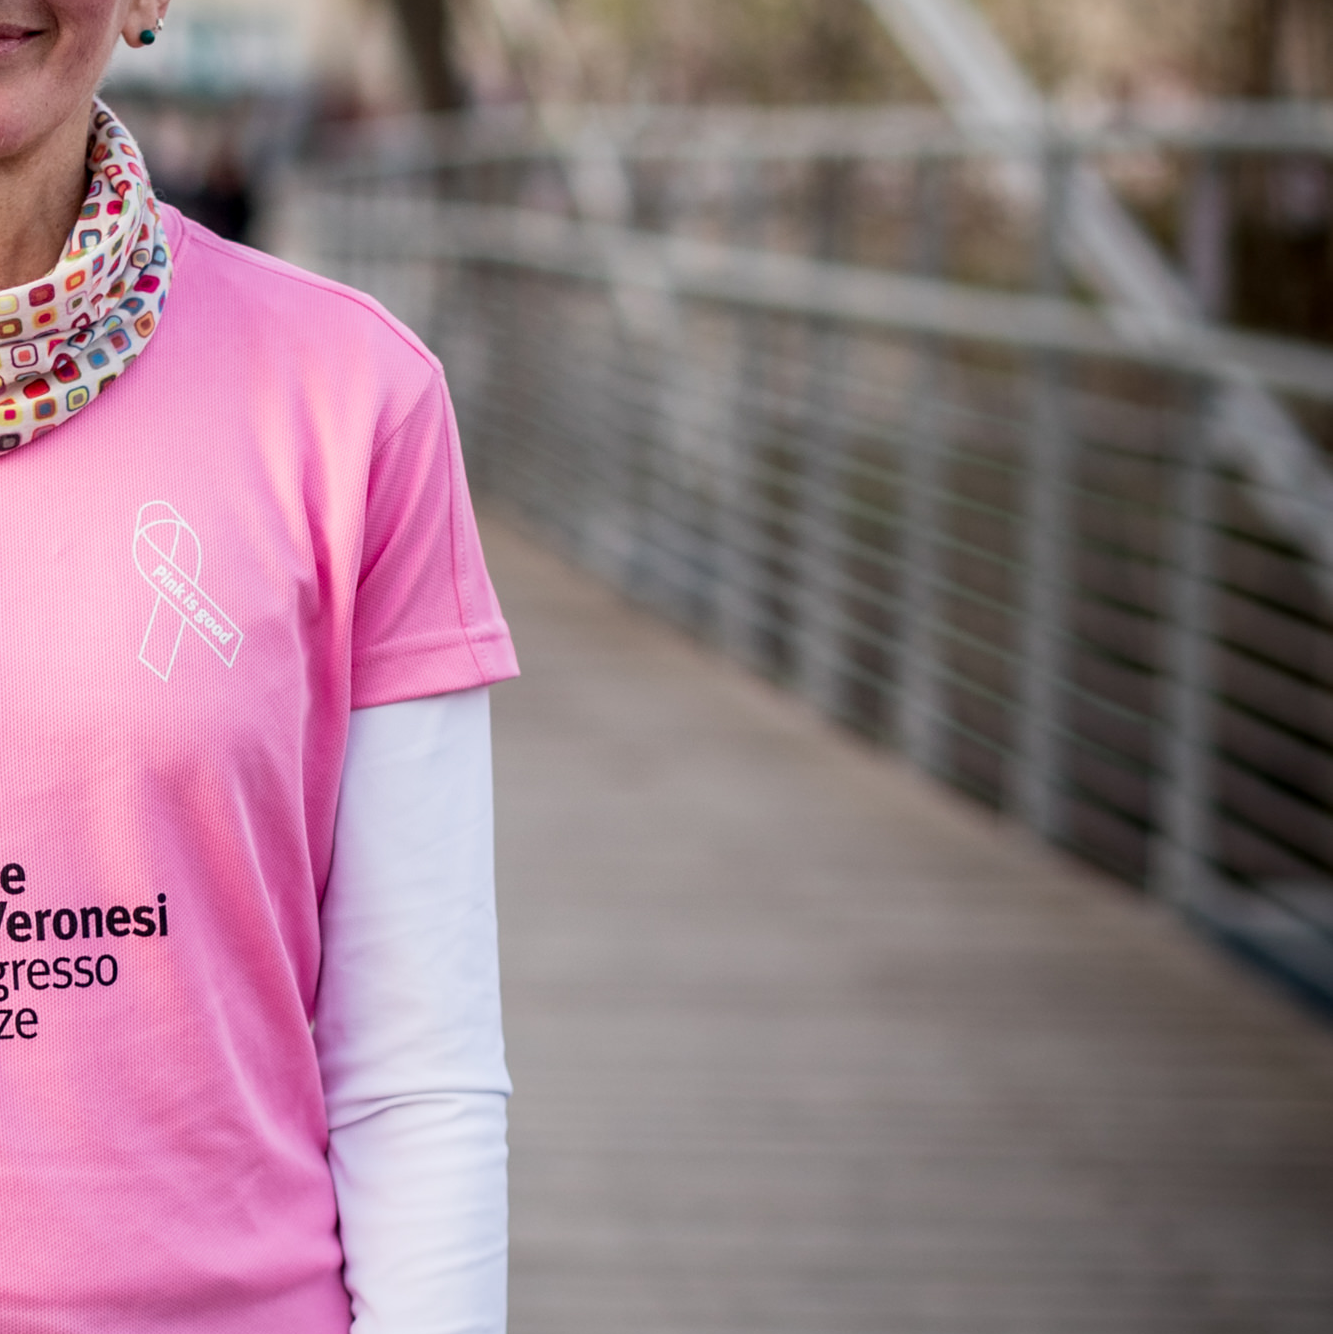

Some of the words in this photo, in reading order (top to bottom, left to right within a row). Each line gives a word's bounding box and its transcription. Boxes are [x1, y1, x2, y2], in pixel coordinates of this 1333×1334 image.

[152, 564, 186, 599] Pink
[183, 593, 198, 611] is
[193, 608, 234, 645] good
